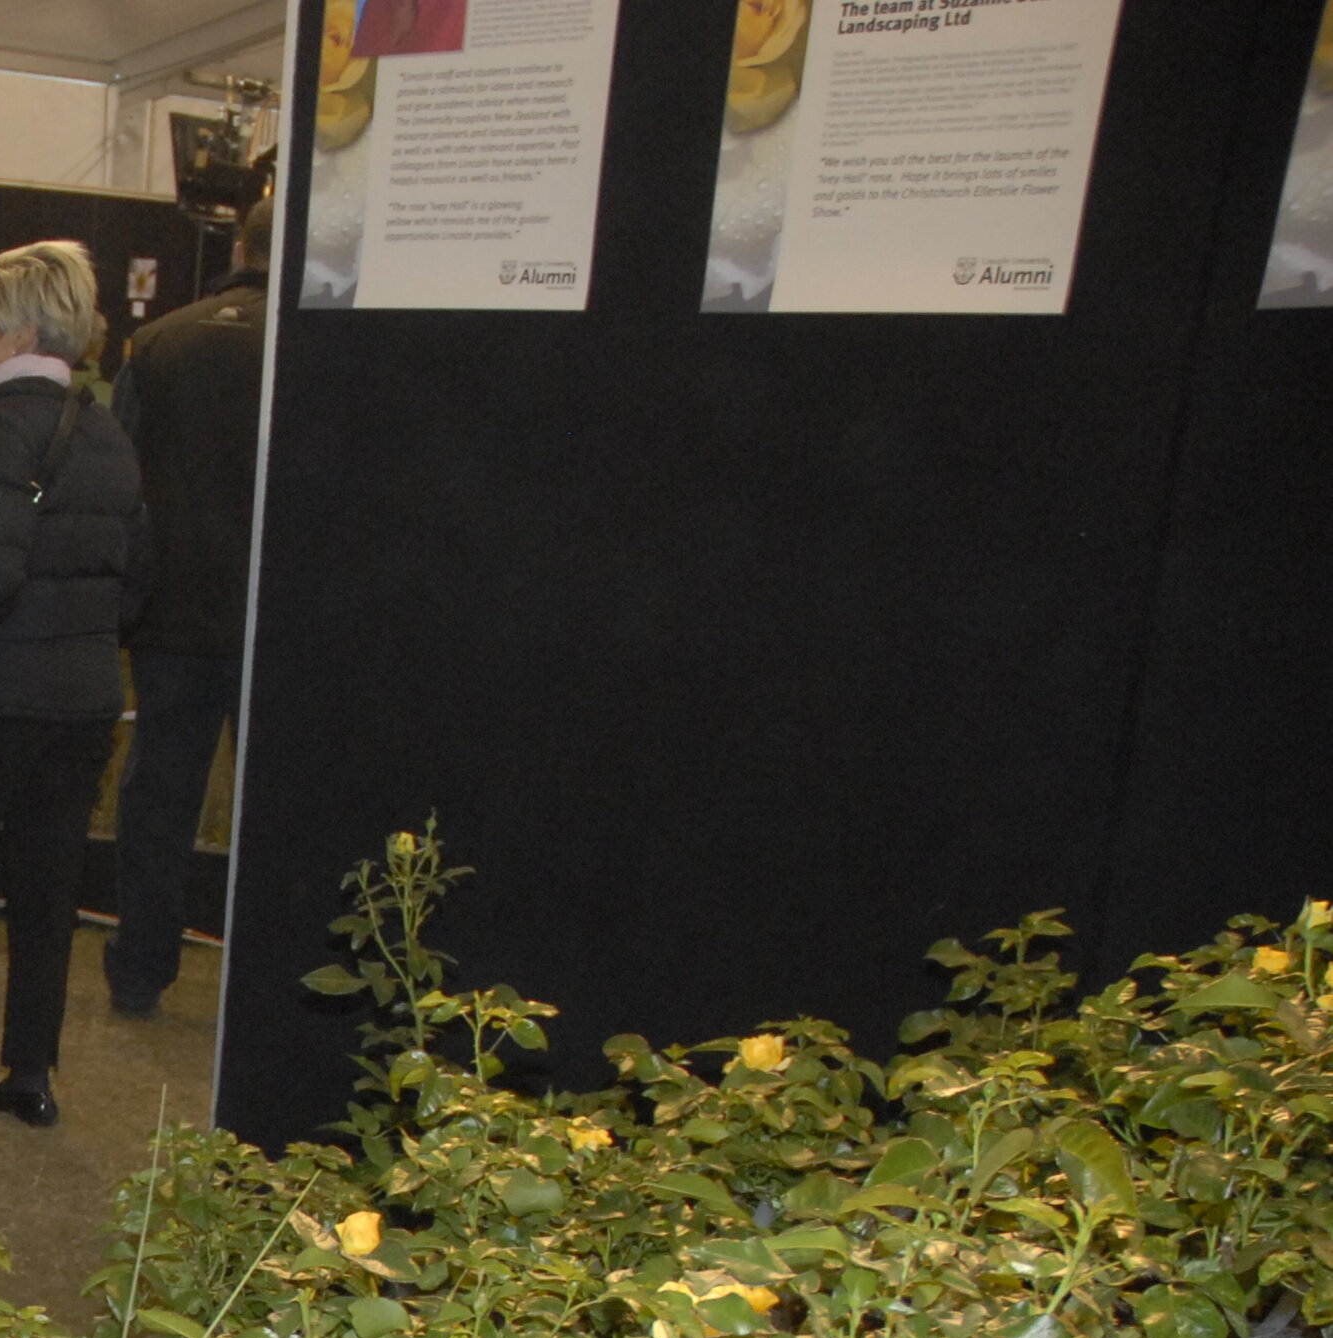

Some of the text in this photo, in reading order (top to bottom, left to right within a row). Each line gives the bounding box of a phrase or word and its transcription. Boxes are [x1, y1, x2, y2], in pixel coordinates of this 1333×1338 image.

[841, 2, 869, 17] The
[874, 1, 913, 14] team
[917, 0, 934, 11] at
[837, 10, 972, 35] Landscaping Ltd
[842, 156, 867, 167] wish
[907, 154, 926, 165] the
[927, 152, 954, 164] best
[973, 151, 992, 163] the
[994, 149, 1033, 161] launch
[901, 172, 932, 186] Hope
[941, 169, 979, 183] brings
[901, 186, 971, 200] Christchurch
[1020, 183, 1060, 196] Flower
[518, 267, 578, 285] Alumni
[978, 264, 1053, 286] Alumni
